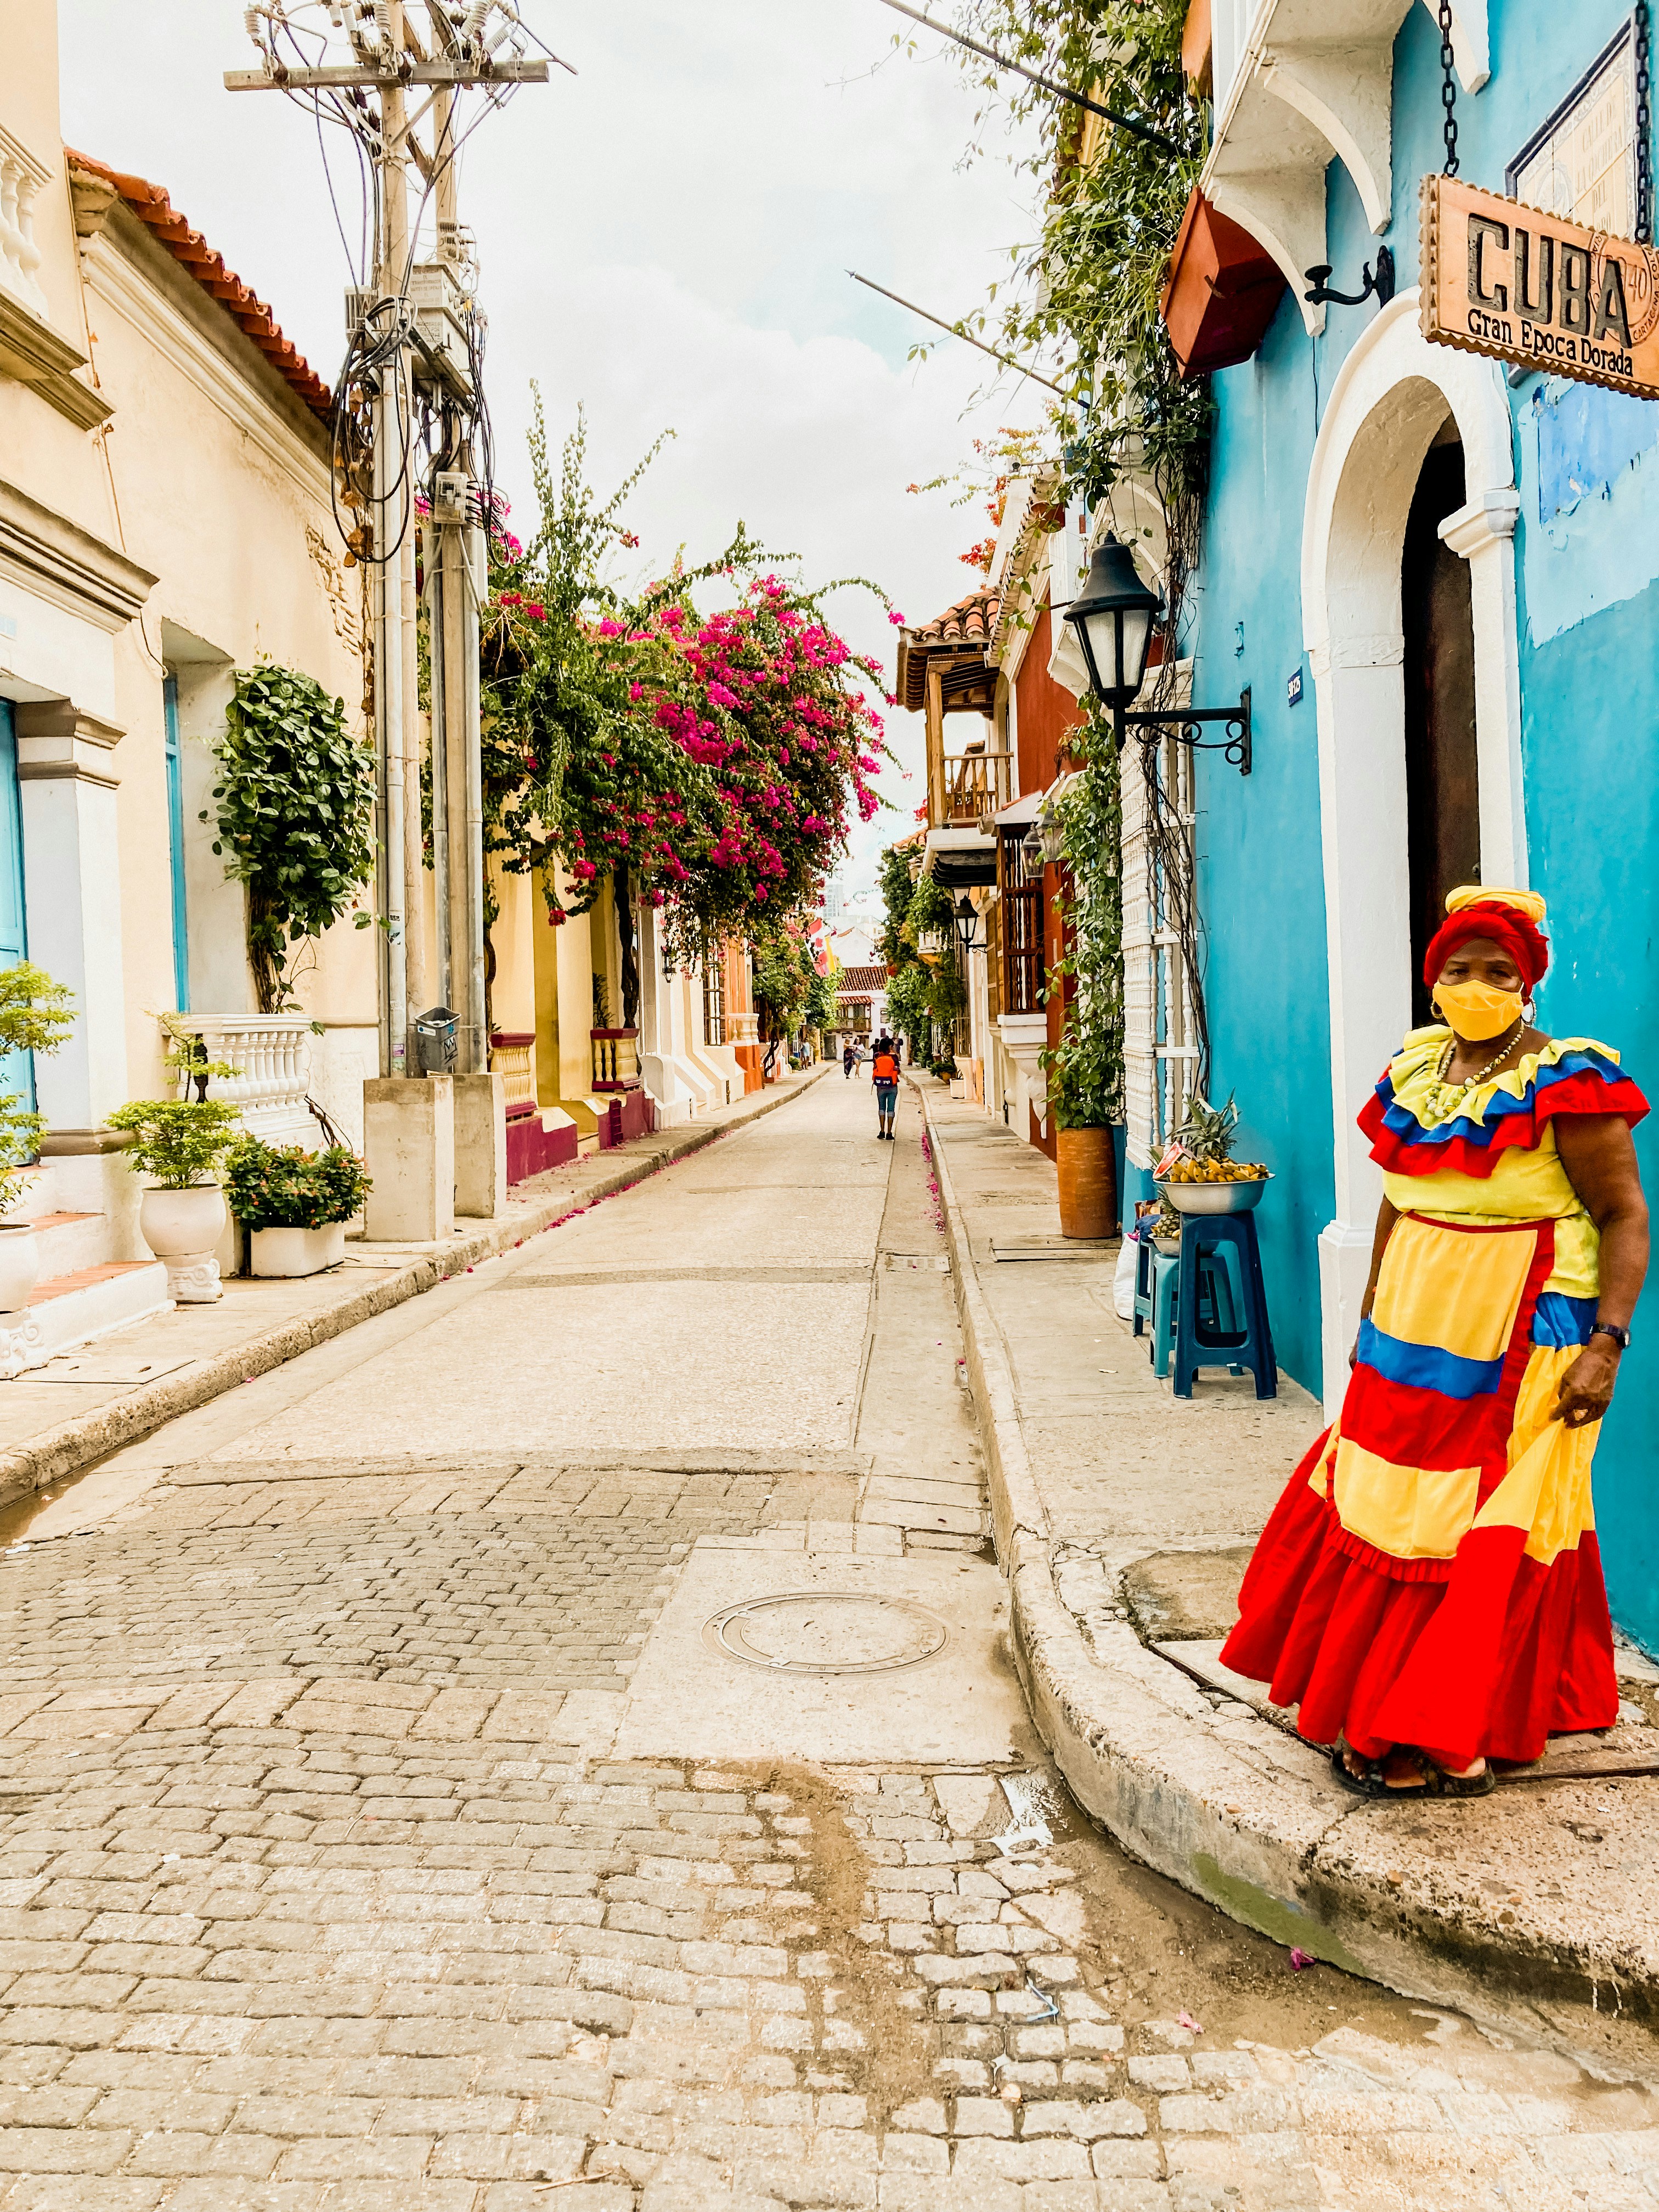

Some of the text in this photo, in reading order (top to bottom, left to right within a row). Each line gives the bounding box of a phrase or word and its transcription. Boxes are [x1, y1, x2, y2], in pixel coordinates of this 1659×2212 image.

[1468, 212, 1632, 348] CUBA
[1468, 308, 1634, 377] Gran Epoca Dorada
